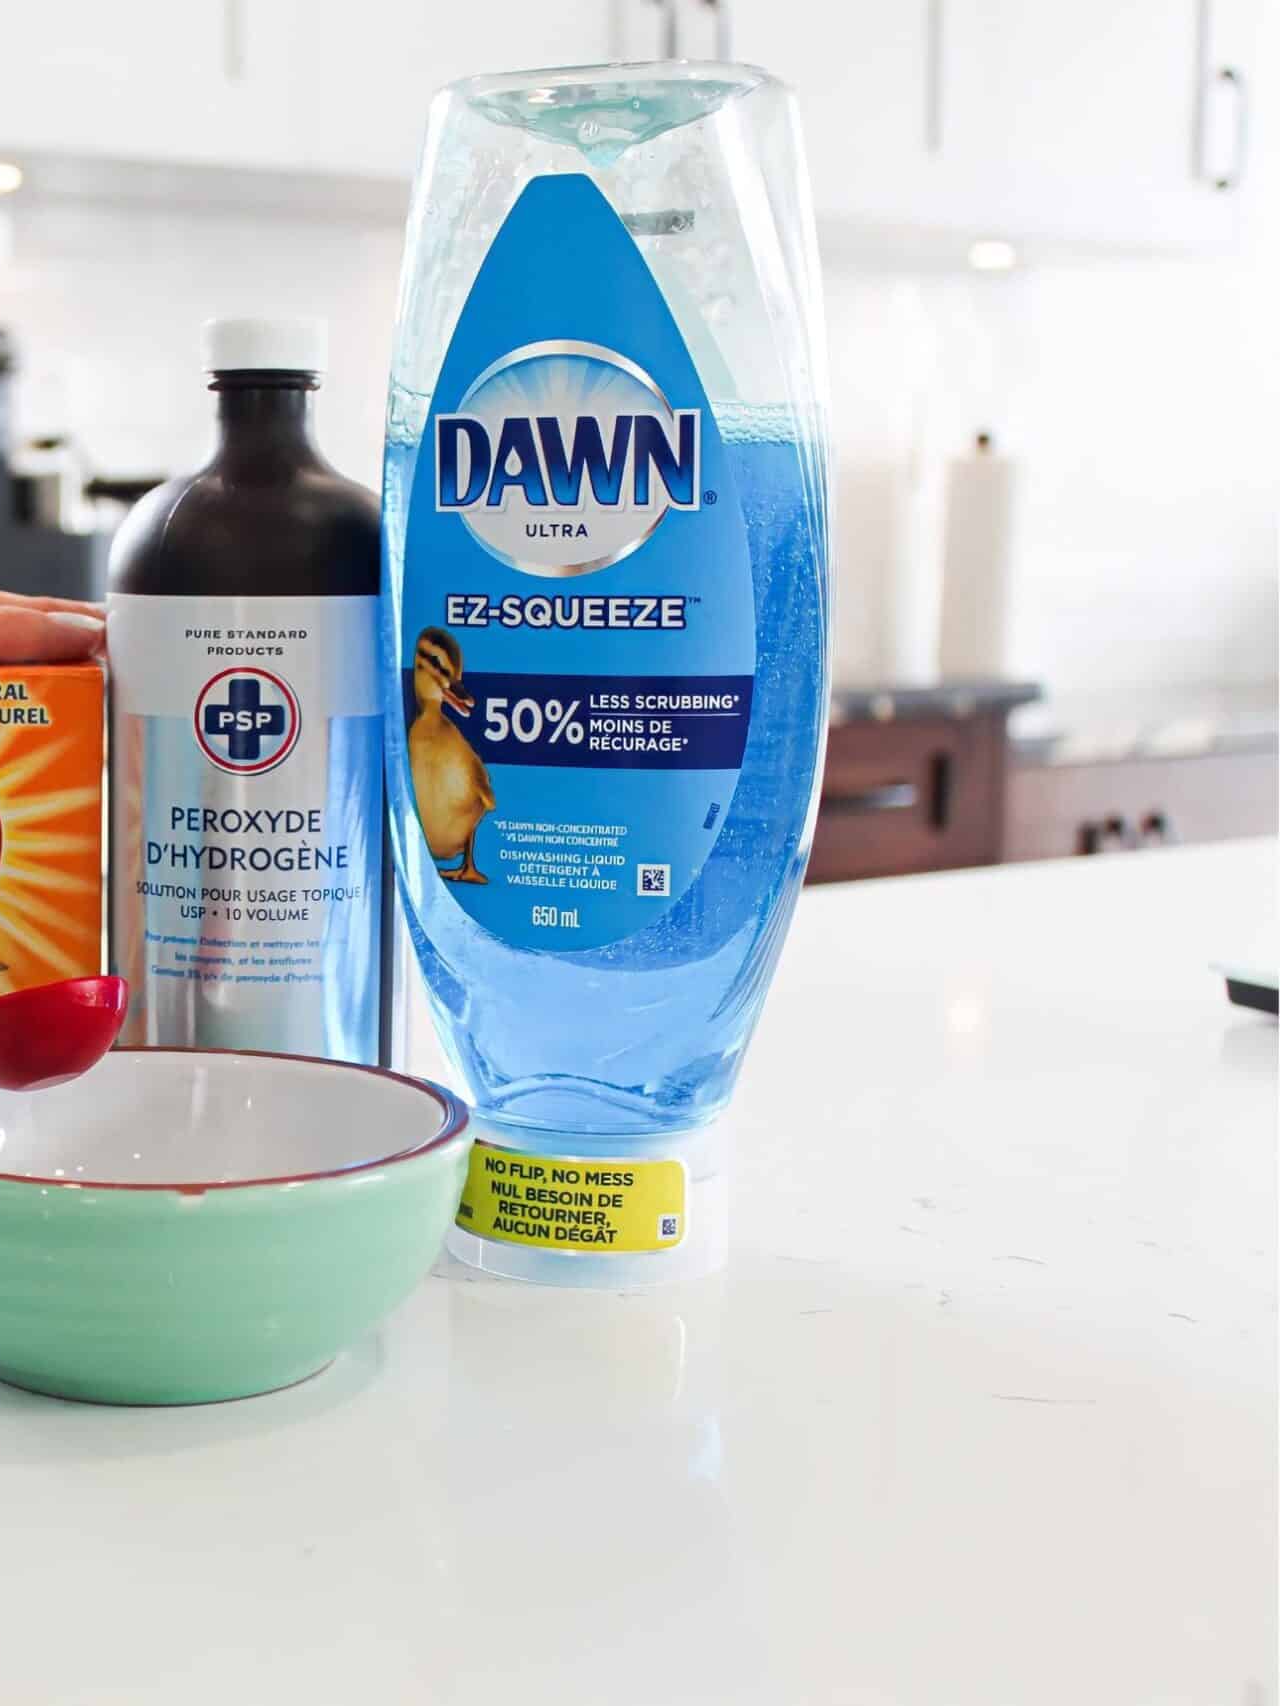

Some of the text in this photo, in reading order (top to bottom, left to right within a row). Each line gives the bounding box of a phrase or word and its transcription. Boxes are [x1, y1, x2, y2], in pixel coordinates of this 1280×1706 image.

[435, 409, 701, 512] DAWN
[525, 524, 588, 538] ULTRA
[447, 594, 686, 628] EZ-SQUEEZE
[185, 630, 307, 639] PURE STANDARD
[207, 647, 284, 656] PRODUCTS
[589, 695, 630, 709] LESS
[220, 711, 272, 731] PSP
[483, 698, 584, 744] 50%
[589, 719, 672, 733] MOINS DE
[171, 807, 321, 833] PEROXYDE
[147, 840, 349, 871] D'HYDROGÈNE
[500, 849, 625, 865] DISHWASHING LIQUID
[136, 881, 361, 902] SOLUTION POUR USAGE TOPIQUE
[507, 875, 616, 890] VAISSELLE LIQUIDE
[181, 905, 309, 921] USP 10 VOLUME
[532, 906, 580, 928] 650 mL
[485, 1157, 633, 1186] NO FLIP, NO MESS
[491, 1181, 623, 1208] NUL BESOIN DE
[499, 1201, 611, 1229] RETOURNER,
[493, 1217, 617, 1244] AUCUN DÉGÂT
